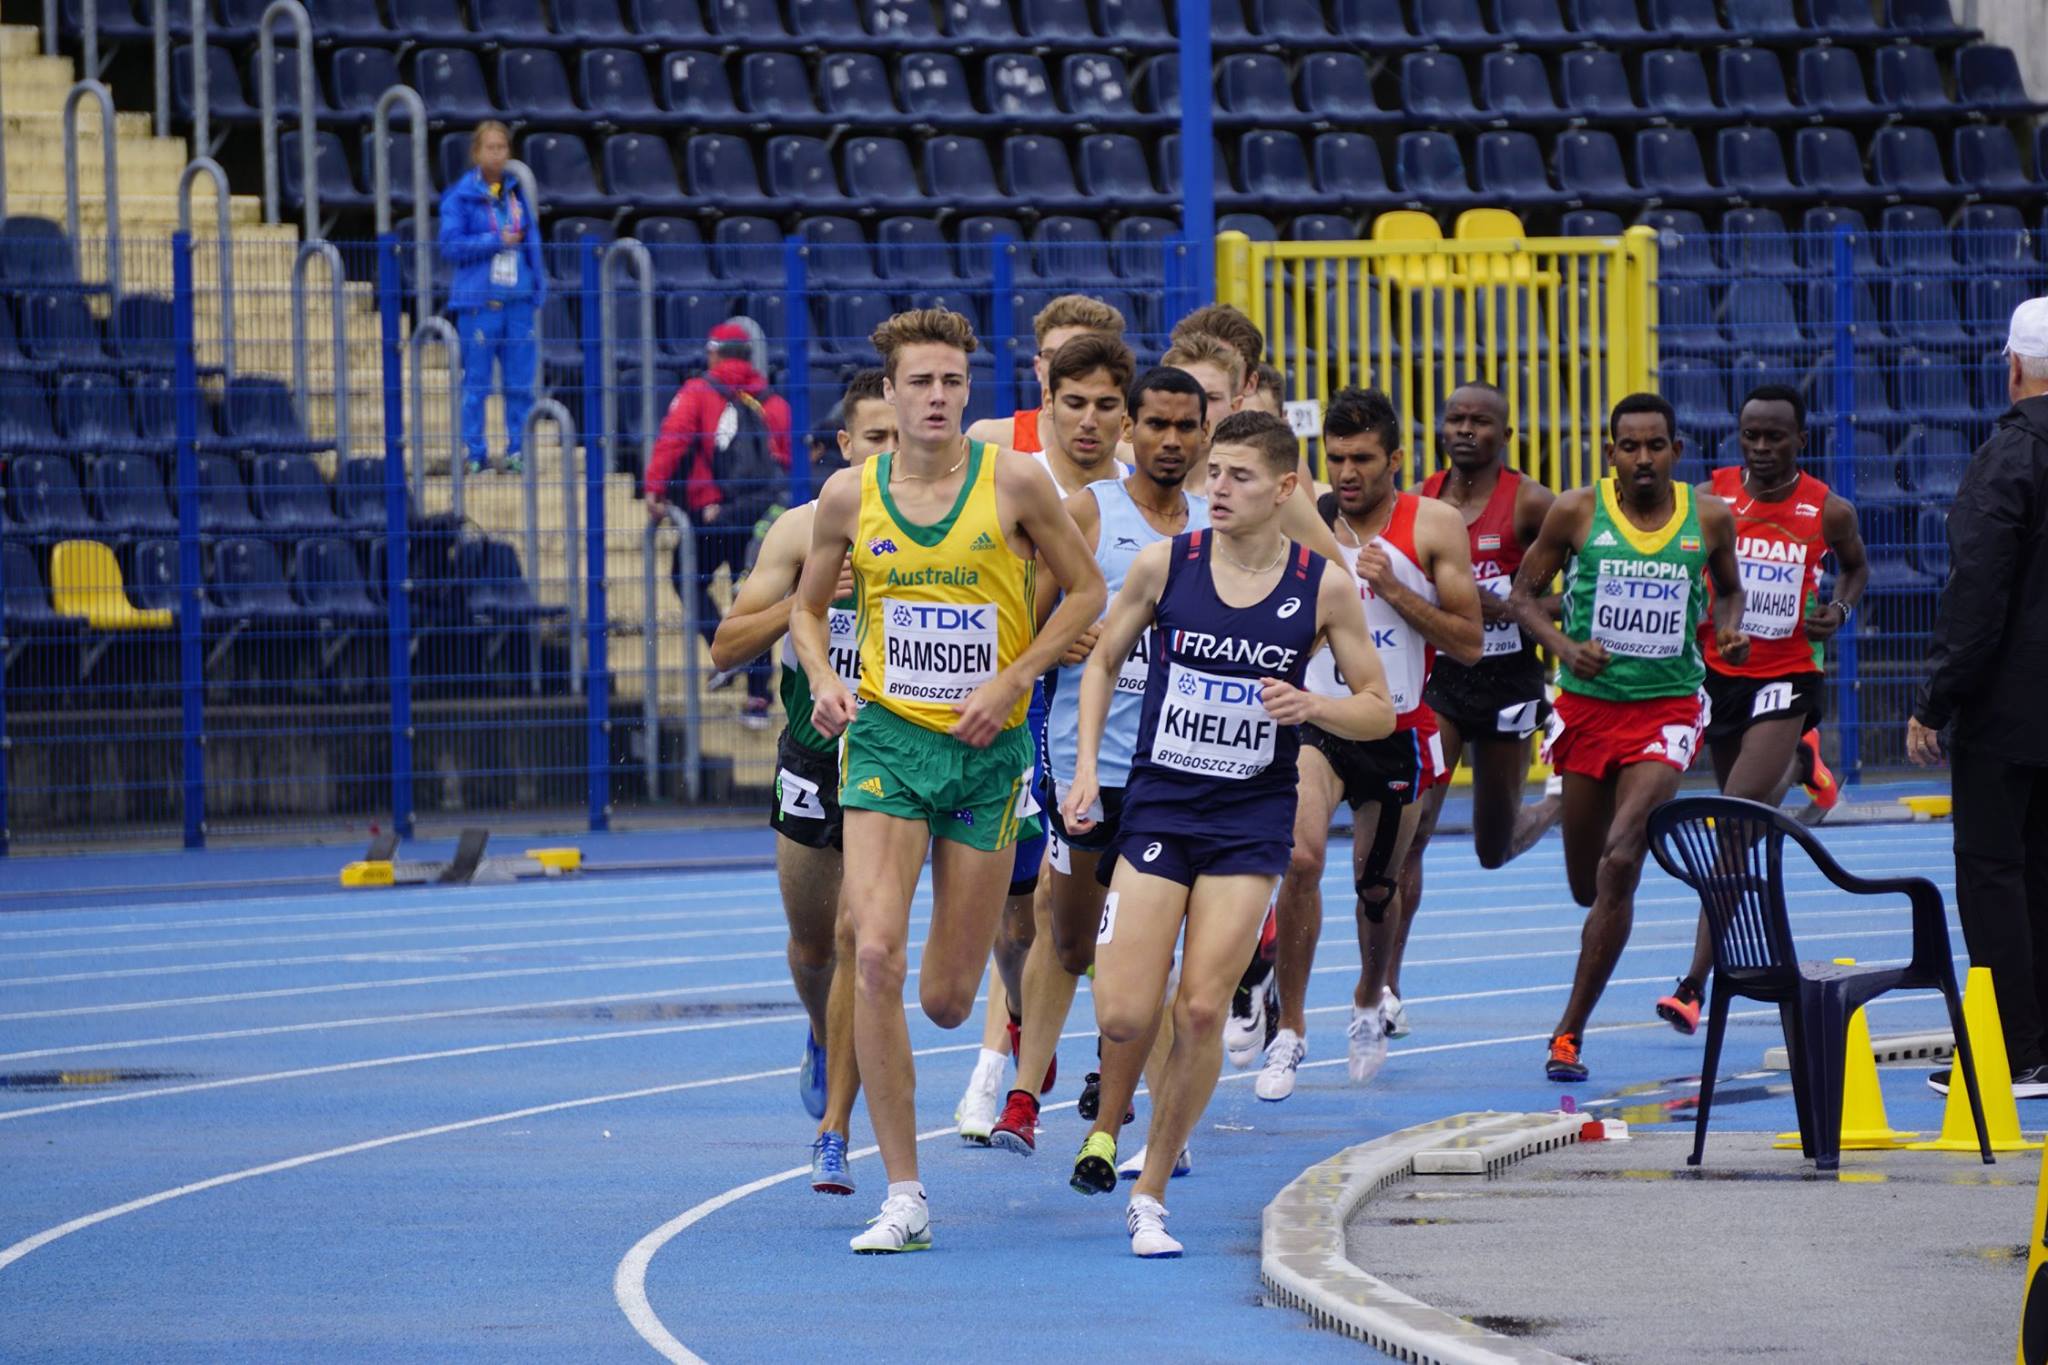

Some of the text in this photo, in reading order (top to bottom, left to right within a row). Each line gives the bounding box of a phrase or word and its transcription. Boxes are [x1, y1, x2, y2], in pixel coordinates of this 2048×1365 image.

[1735, 536, 1808, 563] UDAN
[887, 566, 979, 586] Australia
[1600, 559, 1689, 579] ETHIOPIA
[1740, 561, 1796, 583] TDK
[1623, 580, 1681, 600] TDK
[1744, 588, 1797, 617] LWAHAB
[912, 606, 987, 630] TDK
[1598, 604, 1681, 635] GUADIE
[888, 636, 992, 673] RAMSDEN
[1180, 632, 1298, 672] FRANCE
[1495, 641, 1517, 652] 2016
[889, 682, 963, 700] BYDGOSZCZ
[1198, 677, 1265, 706] TDK
[1763, 689, 1781, 709] 11
[1164, 703, 1272, 751] KHELAF
[1679, 734, 1689, 757] 4
[1157, 749, 1236, 774] BYDGOSZCZ
